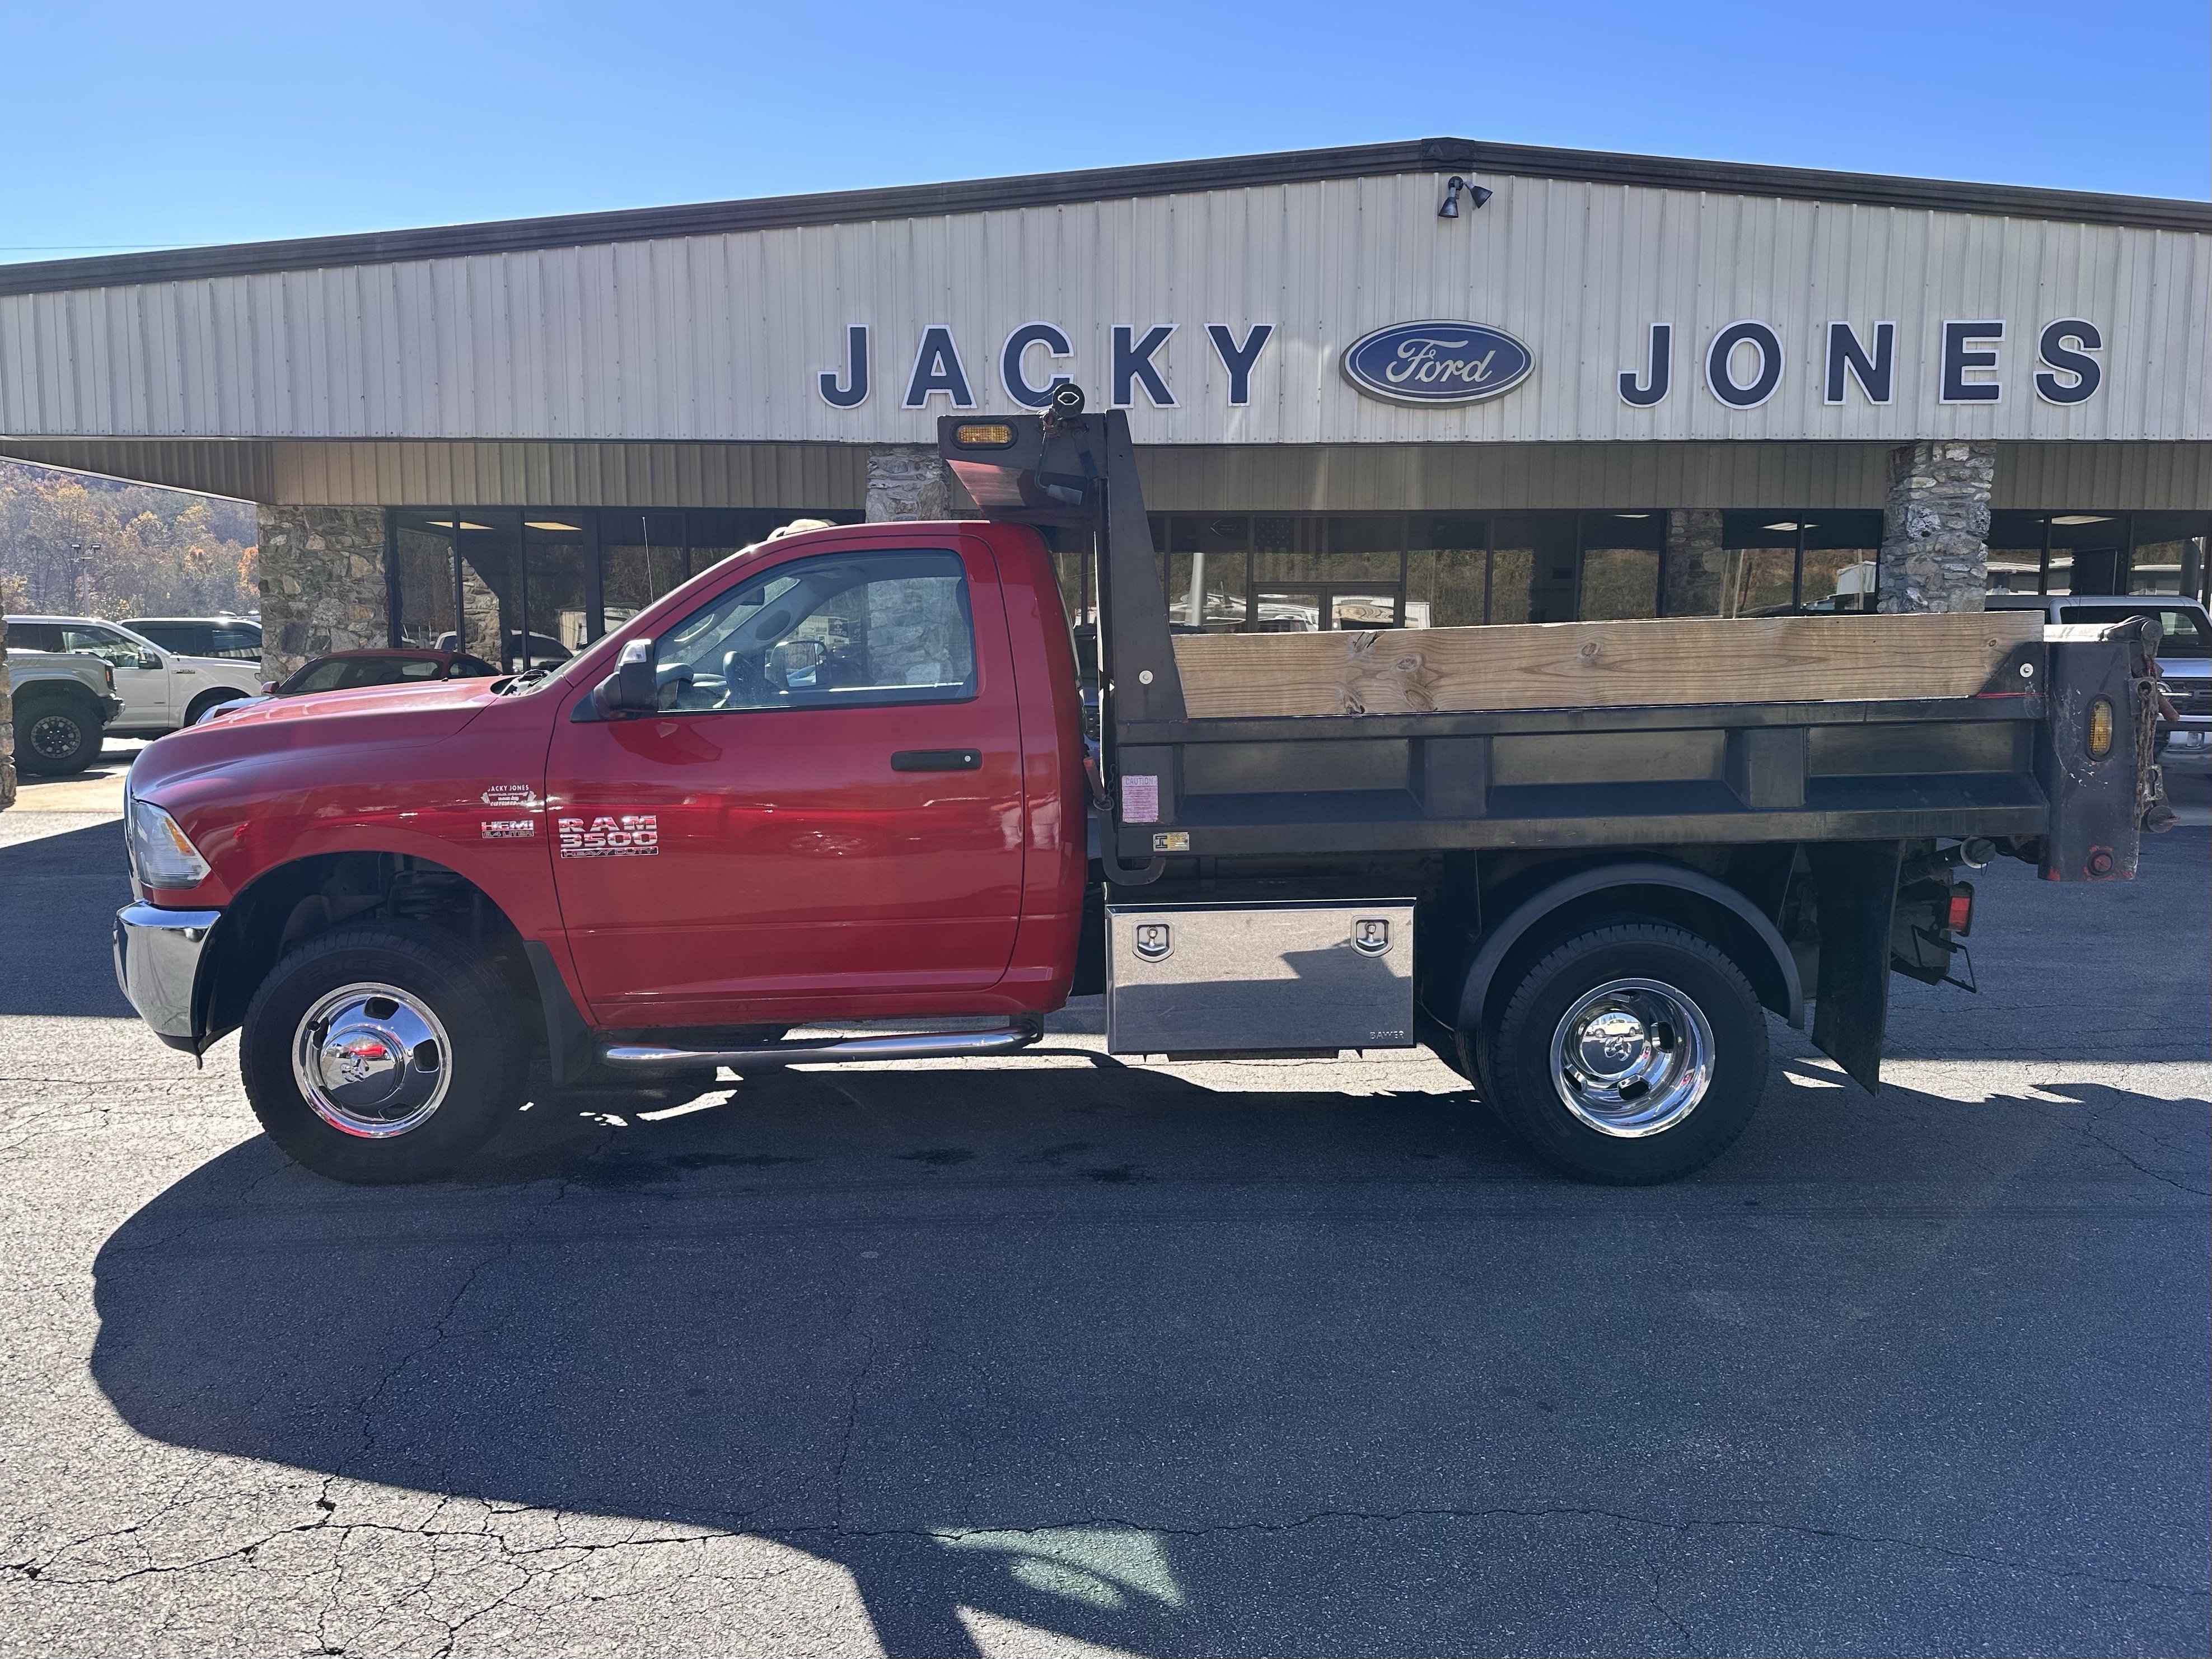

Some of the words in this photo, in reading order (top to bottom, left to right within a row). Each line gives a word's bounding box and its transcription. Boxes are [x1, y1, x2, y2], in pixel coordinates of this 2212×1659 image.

[817, 321, 1276, 409] JACKY
[1617, 317, 2103, 409] JONES
[1386, 338, 1496, 383] Ford
[481, 820, 534, 831] HEMI
[558, 815, 657, 833] RAM
[560, 831, 658, 848] 3500
[564, 849, 613, 857] HEAVY
[1370, 1030, 1404, 1039] BAWER
